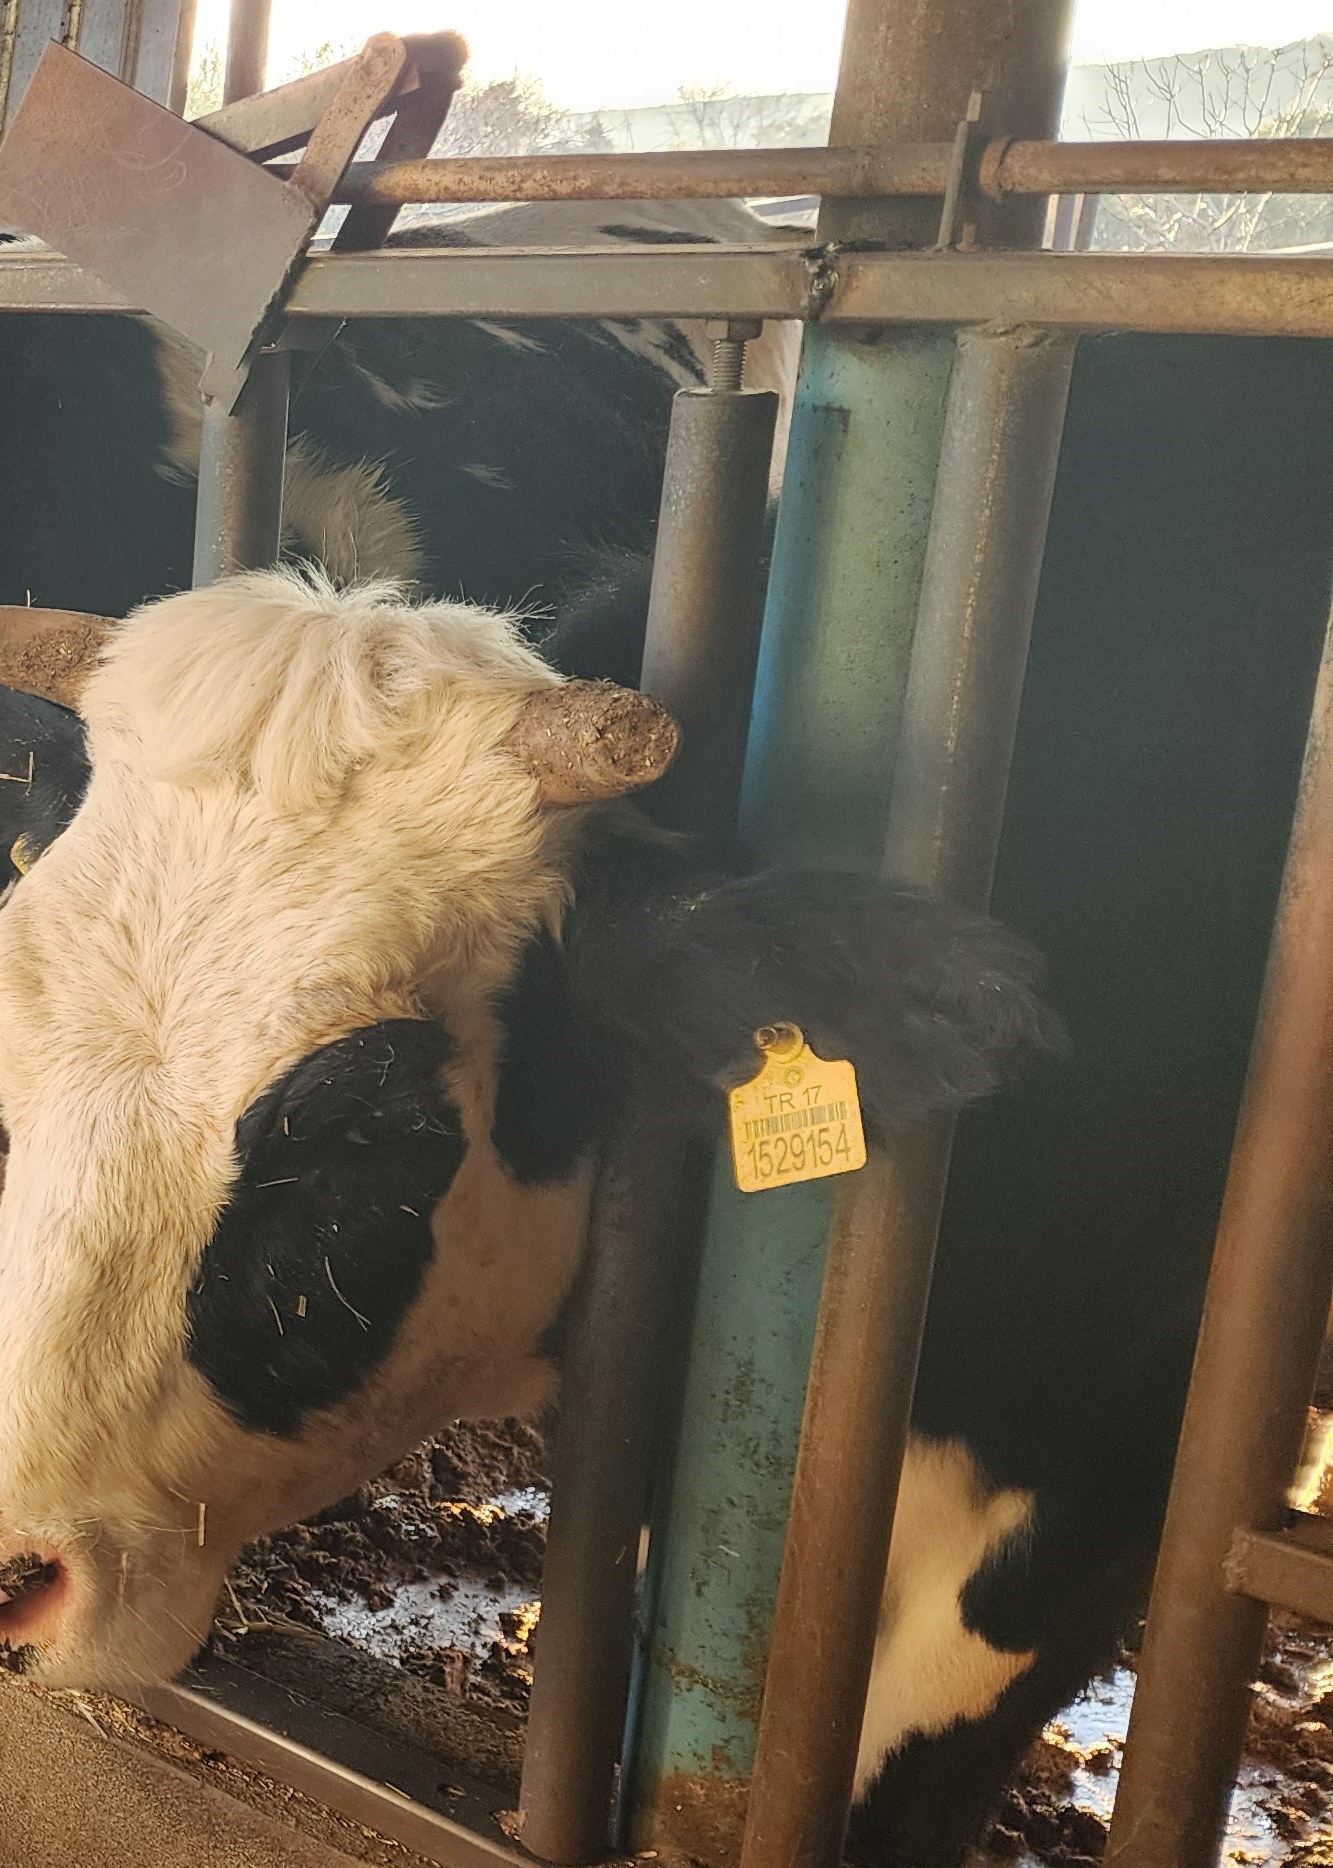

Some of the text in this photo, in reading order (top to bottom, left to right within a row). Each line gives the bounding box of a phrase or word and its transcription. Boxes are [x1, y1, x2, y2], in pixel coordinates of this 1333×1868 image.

[764, 1085, 822, 1114] TR 17
[748, 1123, 851, 1180] 1529154
